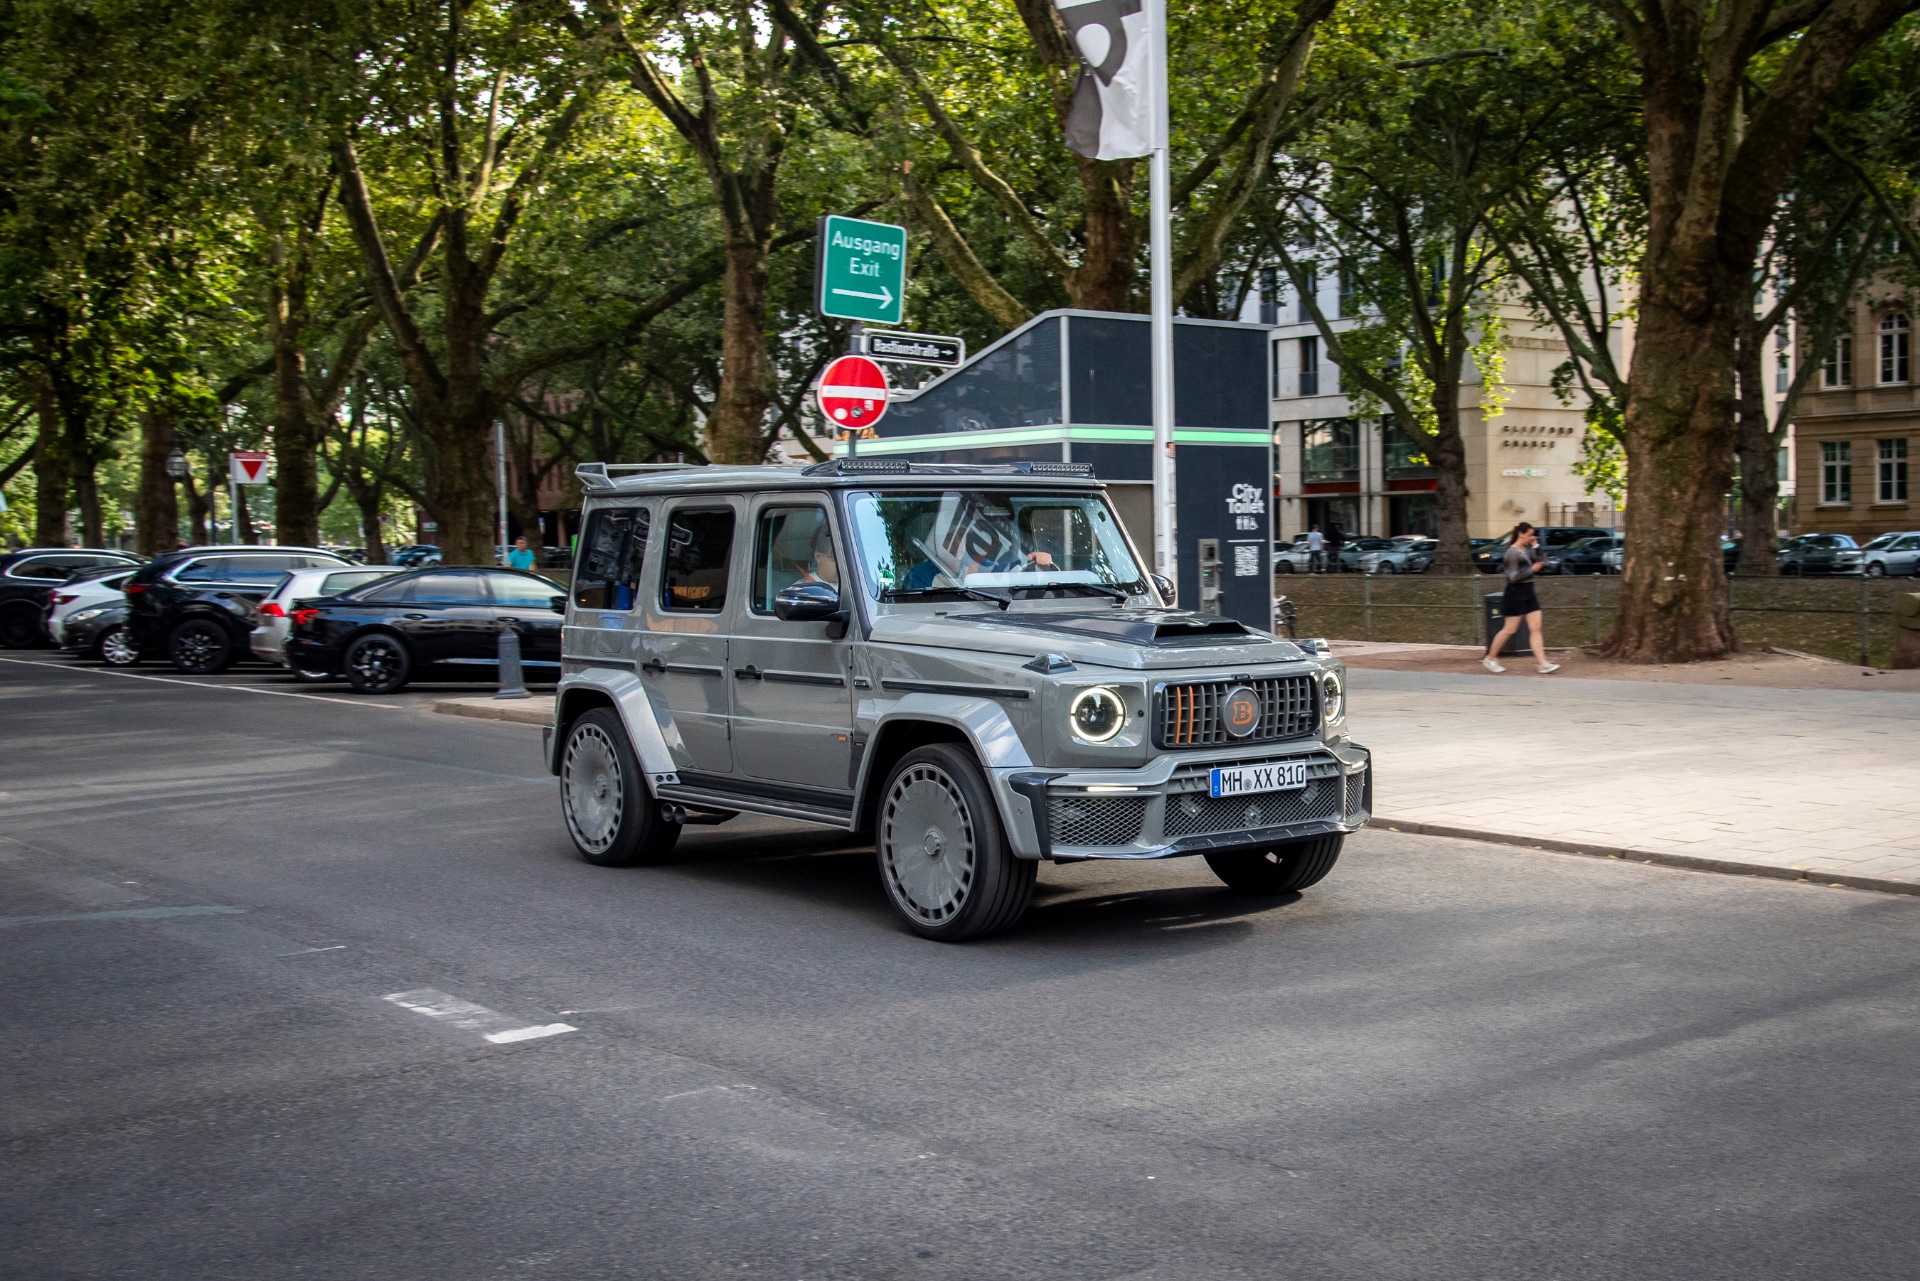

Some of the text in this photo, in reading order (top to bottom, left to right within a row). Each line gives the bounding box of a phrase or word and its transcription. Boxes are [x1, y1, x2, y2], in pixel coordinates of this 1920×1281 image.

[832, 231, 900, 260] Ausgang
[849, 258, 880, 277] Exit
[1232, 484, 1263, 503] City
[1225, 498, 1265, 514] Toilet
[1232, 701, 1253, 725] B
[1221, 770, 1244, 793] MH
[1253, 768, 1273, 789] XX
[1277, 765, 1305, 786] 810
